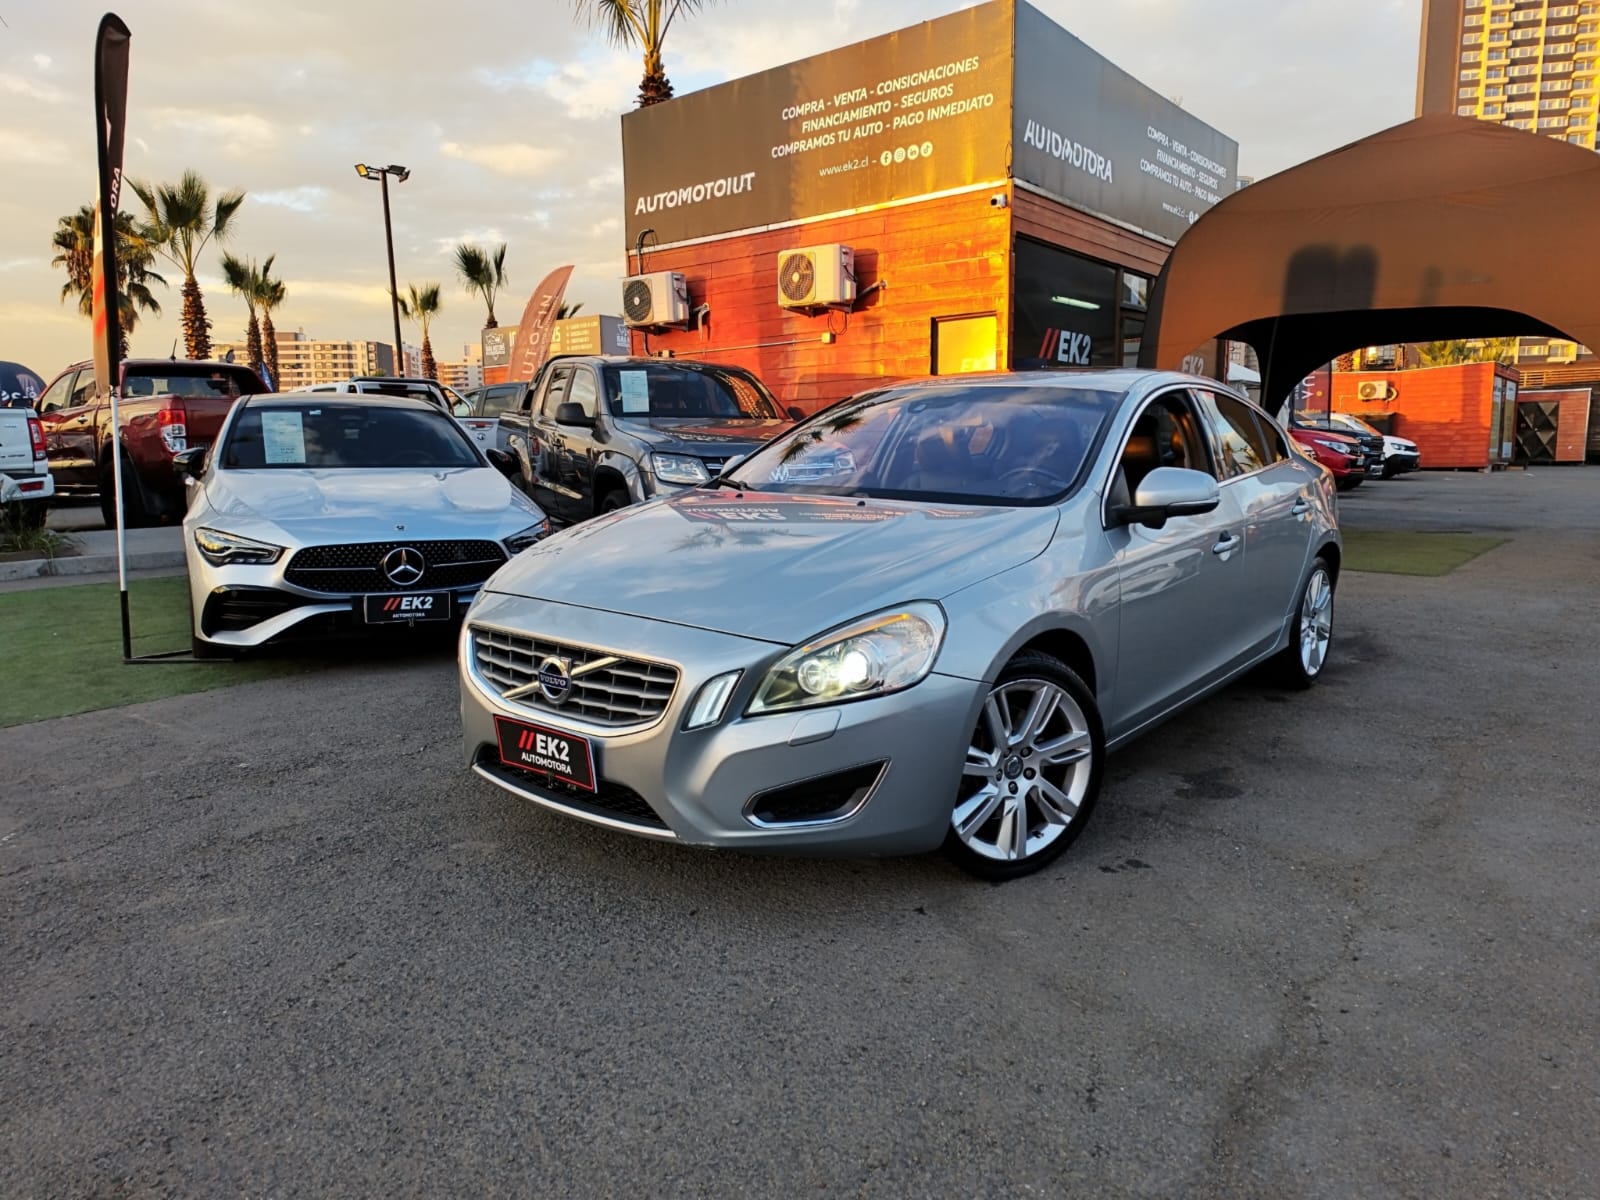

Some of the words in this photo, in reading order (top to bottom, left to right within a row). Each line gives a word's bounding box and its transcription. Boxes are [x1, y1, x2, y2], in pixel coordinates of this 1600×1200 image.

[782, 98, 825, 121] COMPRA
[833, 87, 868, 108] VENTA
[876, 56, 979, 96] CONSIGNACIONES
[801, 100, 892, 133] FINANCIAMIENTO
[901, 84, 954, 109] SEGUROS
[771, 131, 835, 158] COMPRAMOS
[837, 128, 851, 142] TU
[853, 120, 883, 140] AUTO
[892, 110, 924, 130] PAGO
[927, 93, 994, 122] INMEDIATO
[1147, 126, 1169, 148] COMPRA
[1172, 139, 1187, 158] VENTA
[819, 156, 869, 177] www.ek2.cl
[1140, 158, 1172, 184] COMPRAMOS
[1179, 178, 1192, 193] AUTO
[1198, 171, 1218, 190] SEGUROS
[540, 674, 566, 687] VOLVO
[521, 751, 572, 775] AUTOMOTORA
